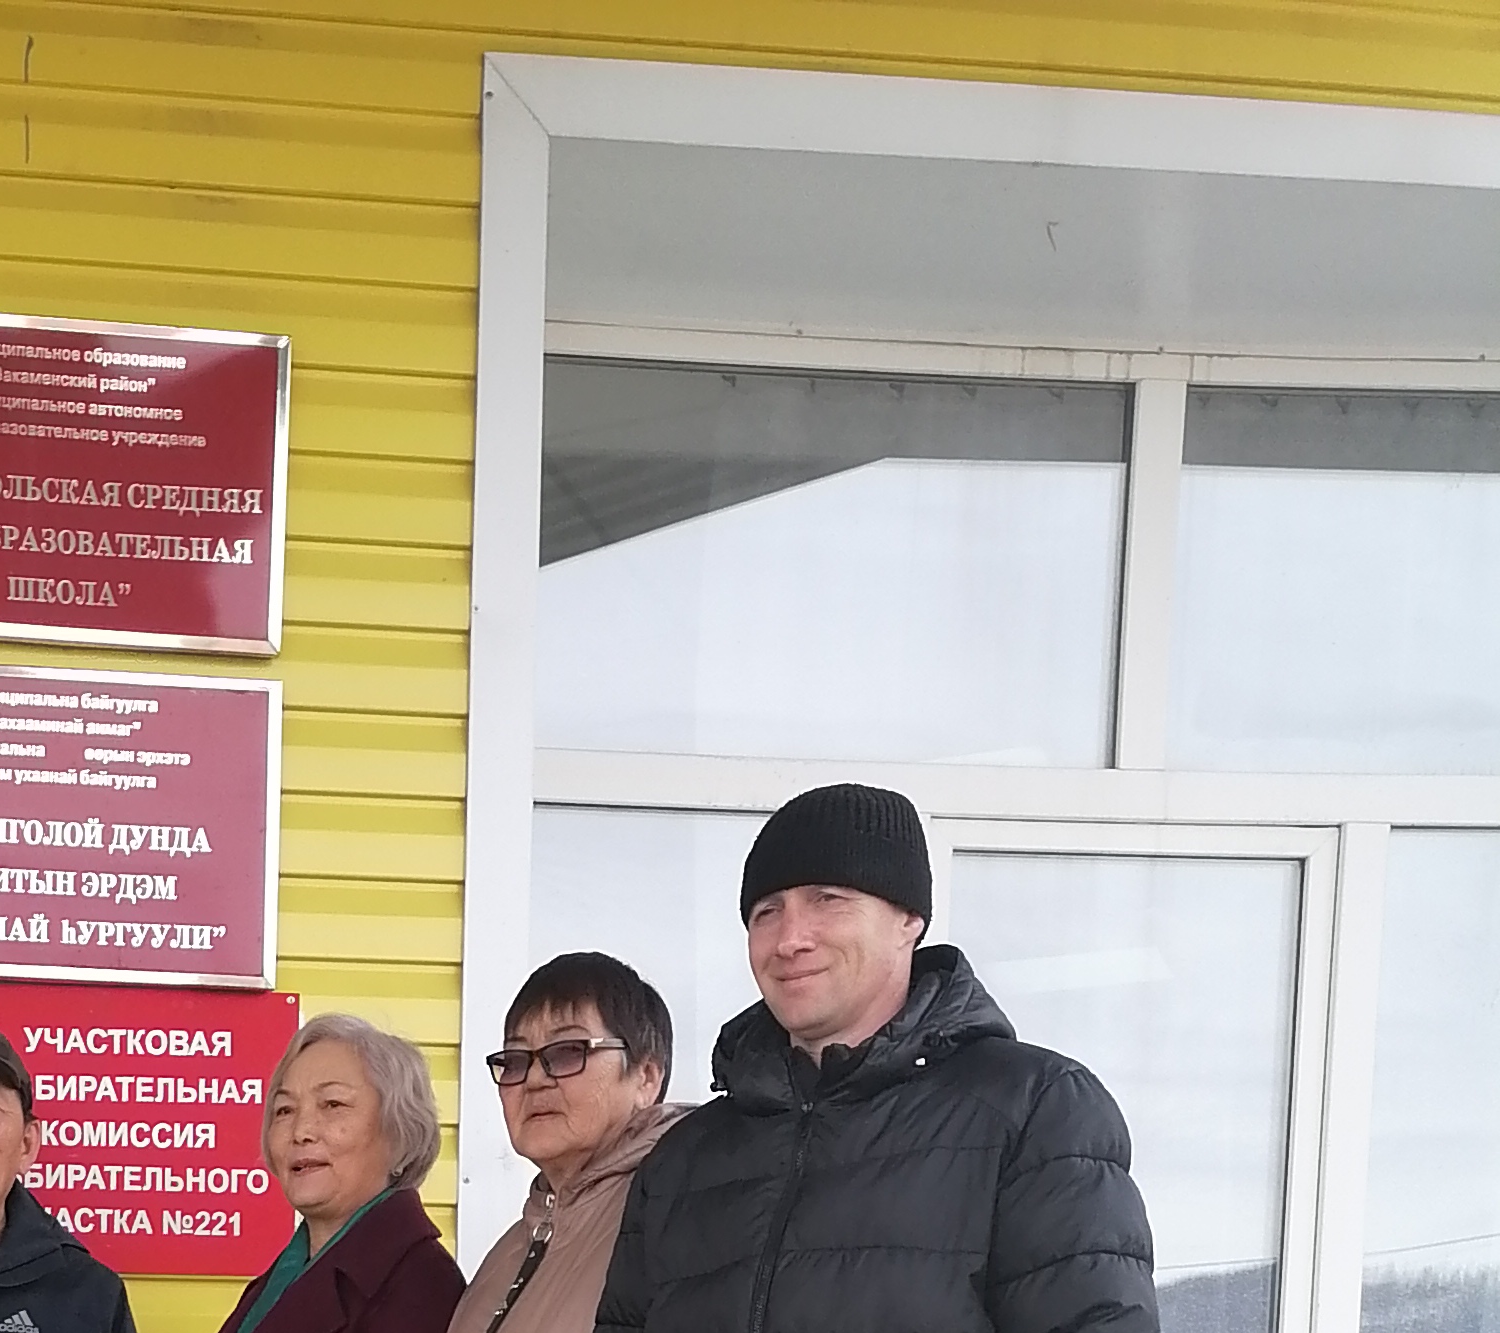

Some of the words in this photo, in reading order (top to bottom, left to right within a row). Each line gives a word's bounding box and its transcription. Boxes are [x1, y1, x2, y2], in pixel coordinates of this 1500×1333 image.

[83, 347, 187, 369] образование
[88, 403, 183, 420] автономное
[112, 430, 207, 447] учреждение
[126, 484, 263, 516] СРЕДНЯЯ
[81, 693, 158, 714] байгуулга
[14, 769, 77, 785] ухаанай
[80, 769, 156, 790] байгуулга
[108, 823, 213, 857] ДУНДА
[81, 874, 178, 904] ЭРДЭМ
[23, 1026, 232, 1057] УЧАСТКОВАЯ
[34, 1074, 263, 1105] БИРАТЕЛЬНАЯ
[41, 1120, 216, 1150] КОМИССИЯ
[16, 1163, 269, 1195] БИРАТЕЛЬНОГО
[45, 1206, 153, 1236] АСТКА
[162, 1209, 242, 1237] №221
